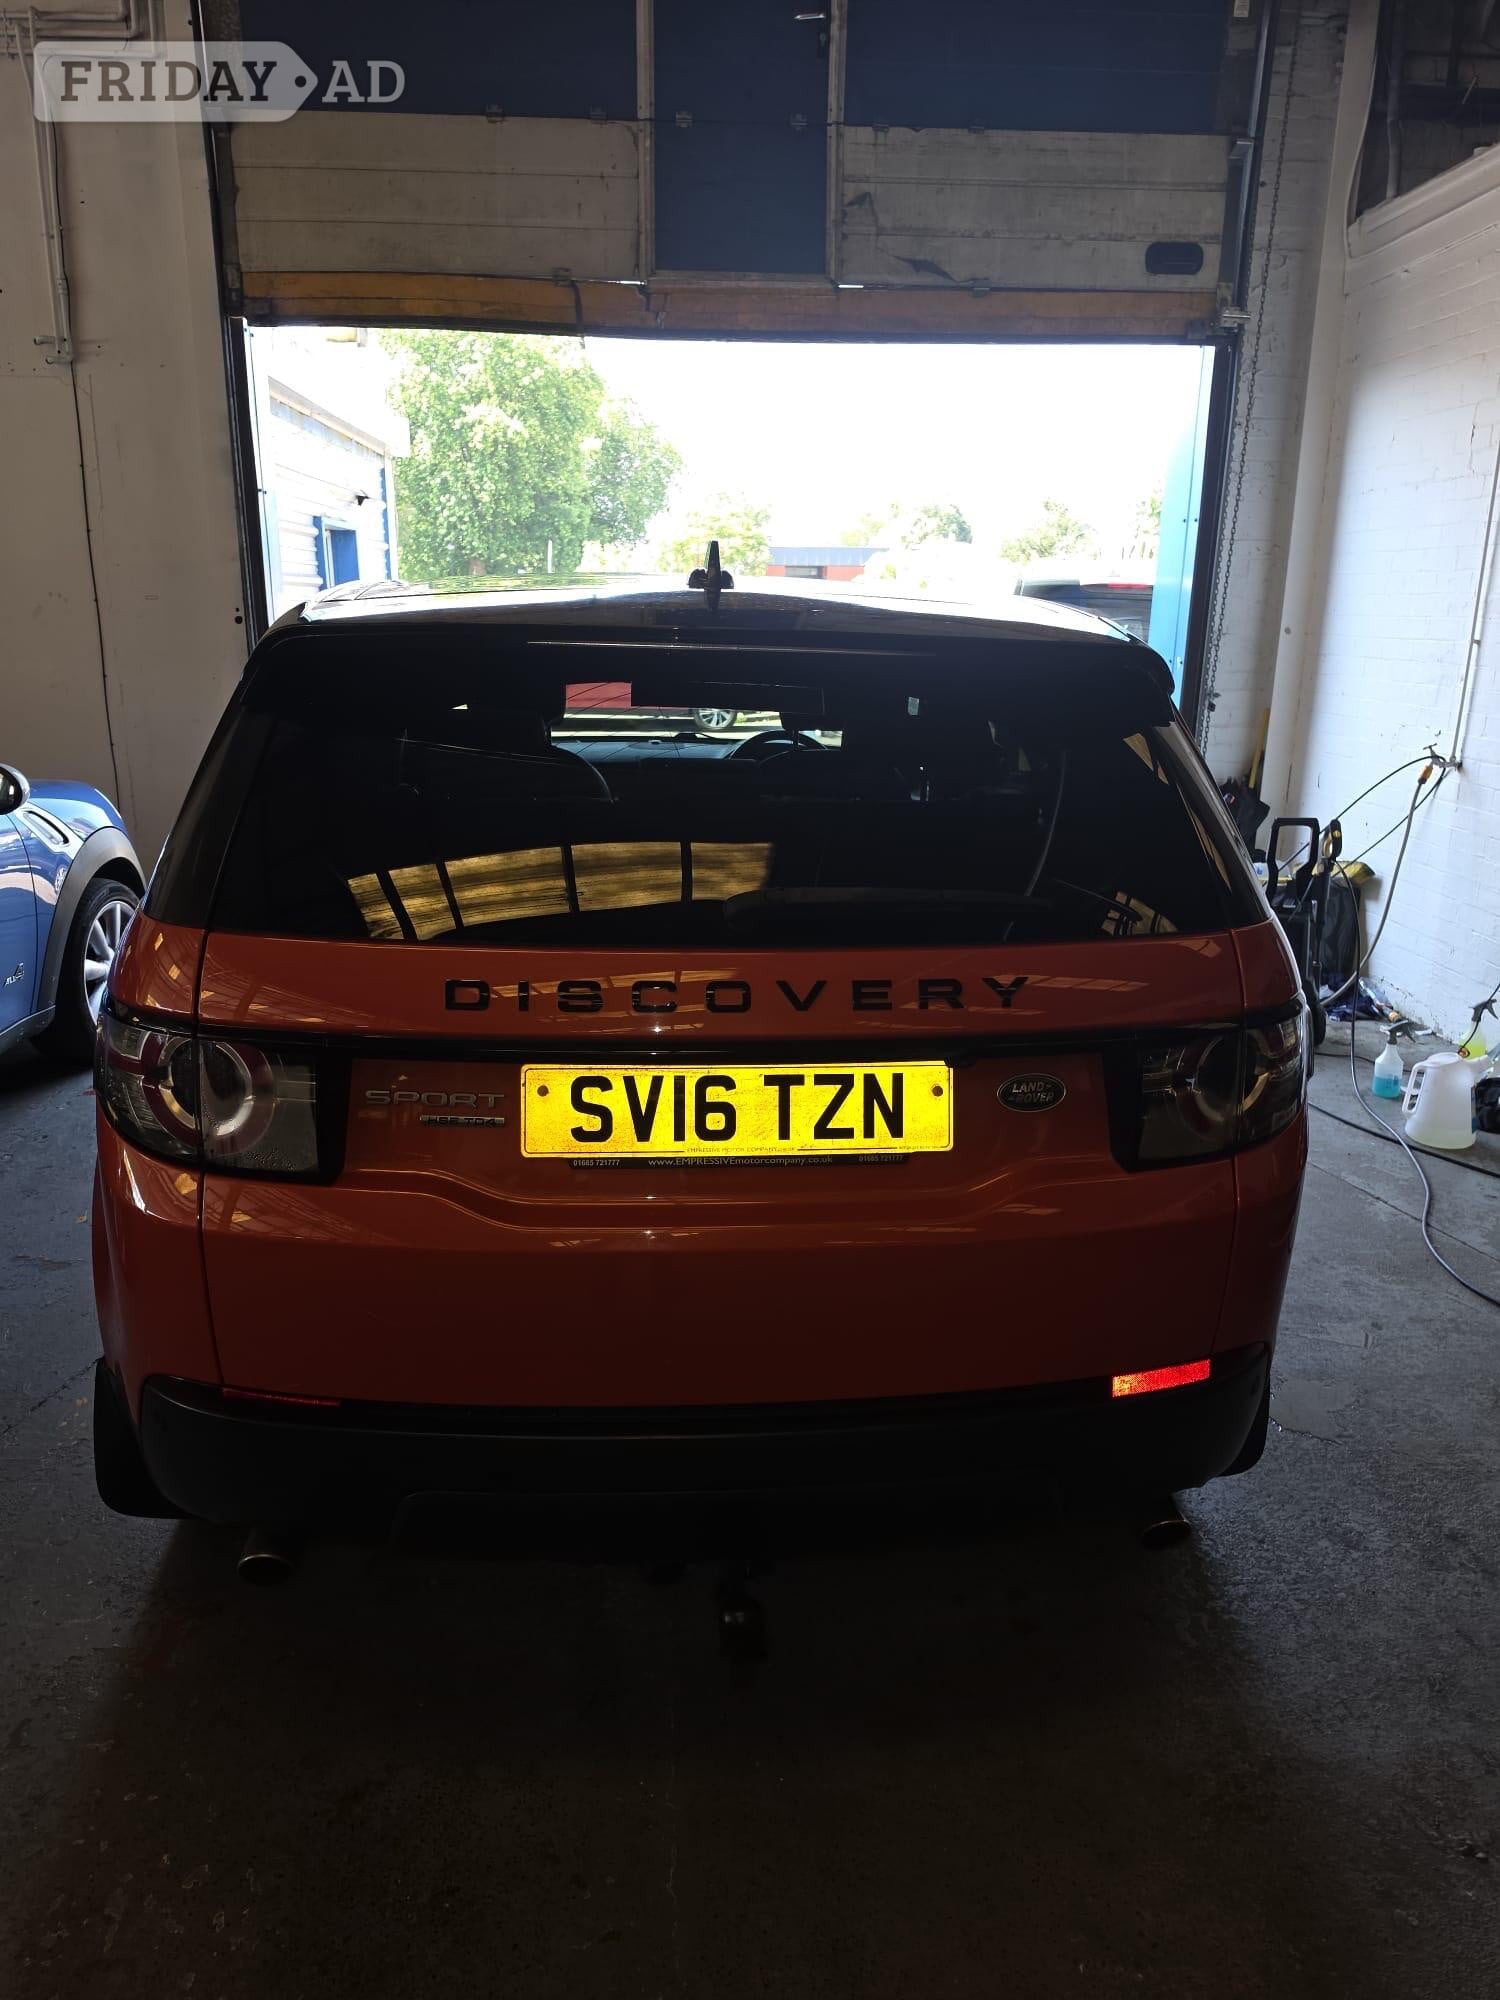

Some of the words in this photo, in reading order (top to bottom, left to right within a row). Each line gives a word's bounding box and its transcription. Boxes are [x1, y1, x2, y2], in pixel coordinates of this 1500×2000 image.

[443, 976, 1030, 1014] DISCOVERY
[365, 1090, 505, 1109] SPORT
[570, 1074, 737, 1143] SV16
[763, 1072, 904, 1141] TZN
[596, 1159, 620, 1167] 721777
